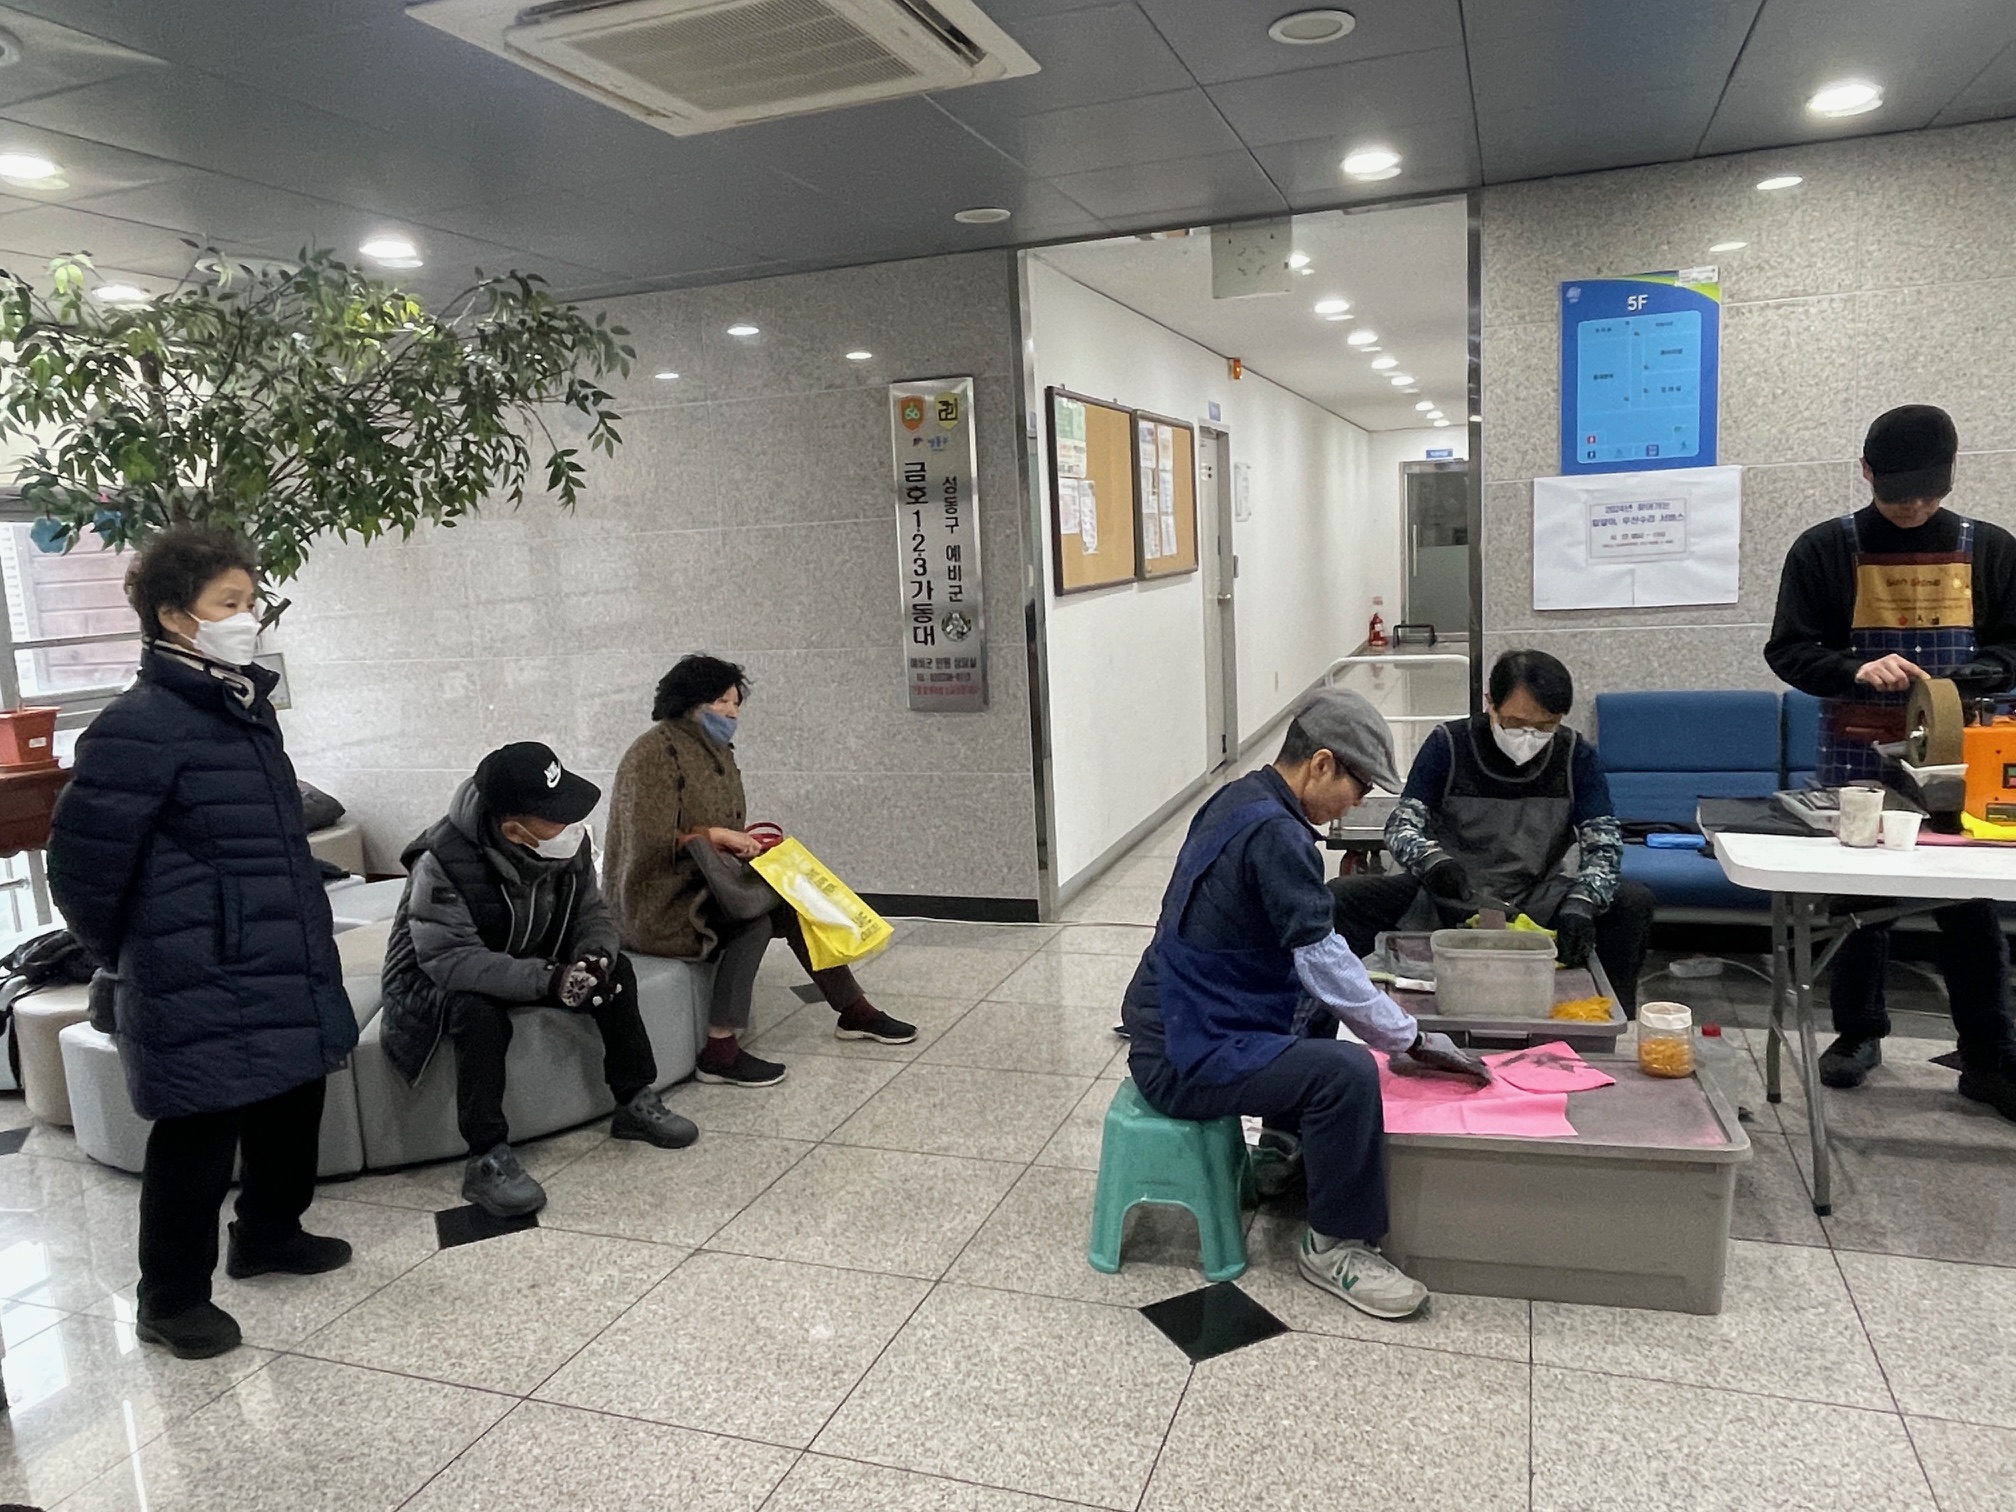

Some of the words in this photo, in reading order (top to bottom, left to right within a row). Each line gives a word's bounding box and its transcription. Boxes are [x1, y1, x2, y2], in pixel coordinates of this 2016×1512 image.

[1627, 294, 1649, 311] 5F
[942, 476, 960, 534] 성동구
[945, 544, 963, 603] 예비군
